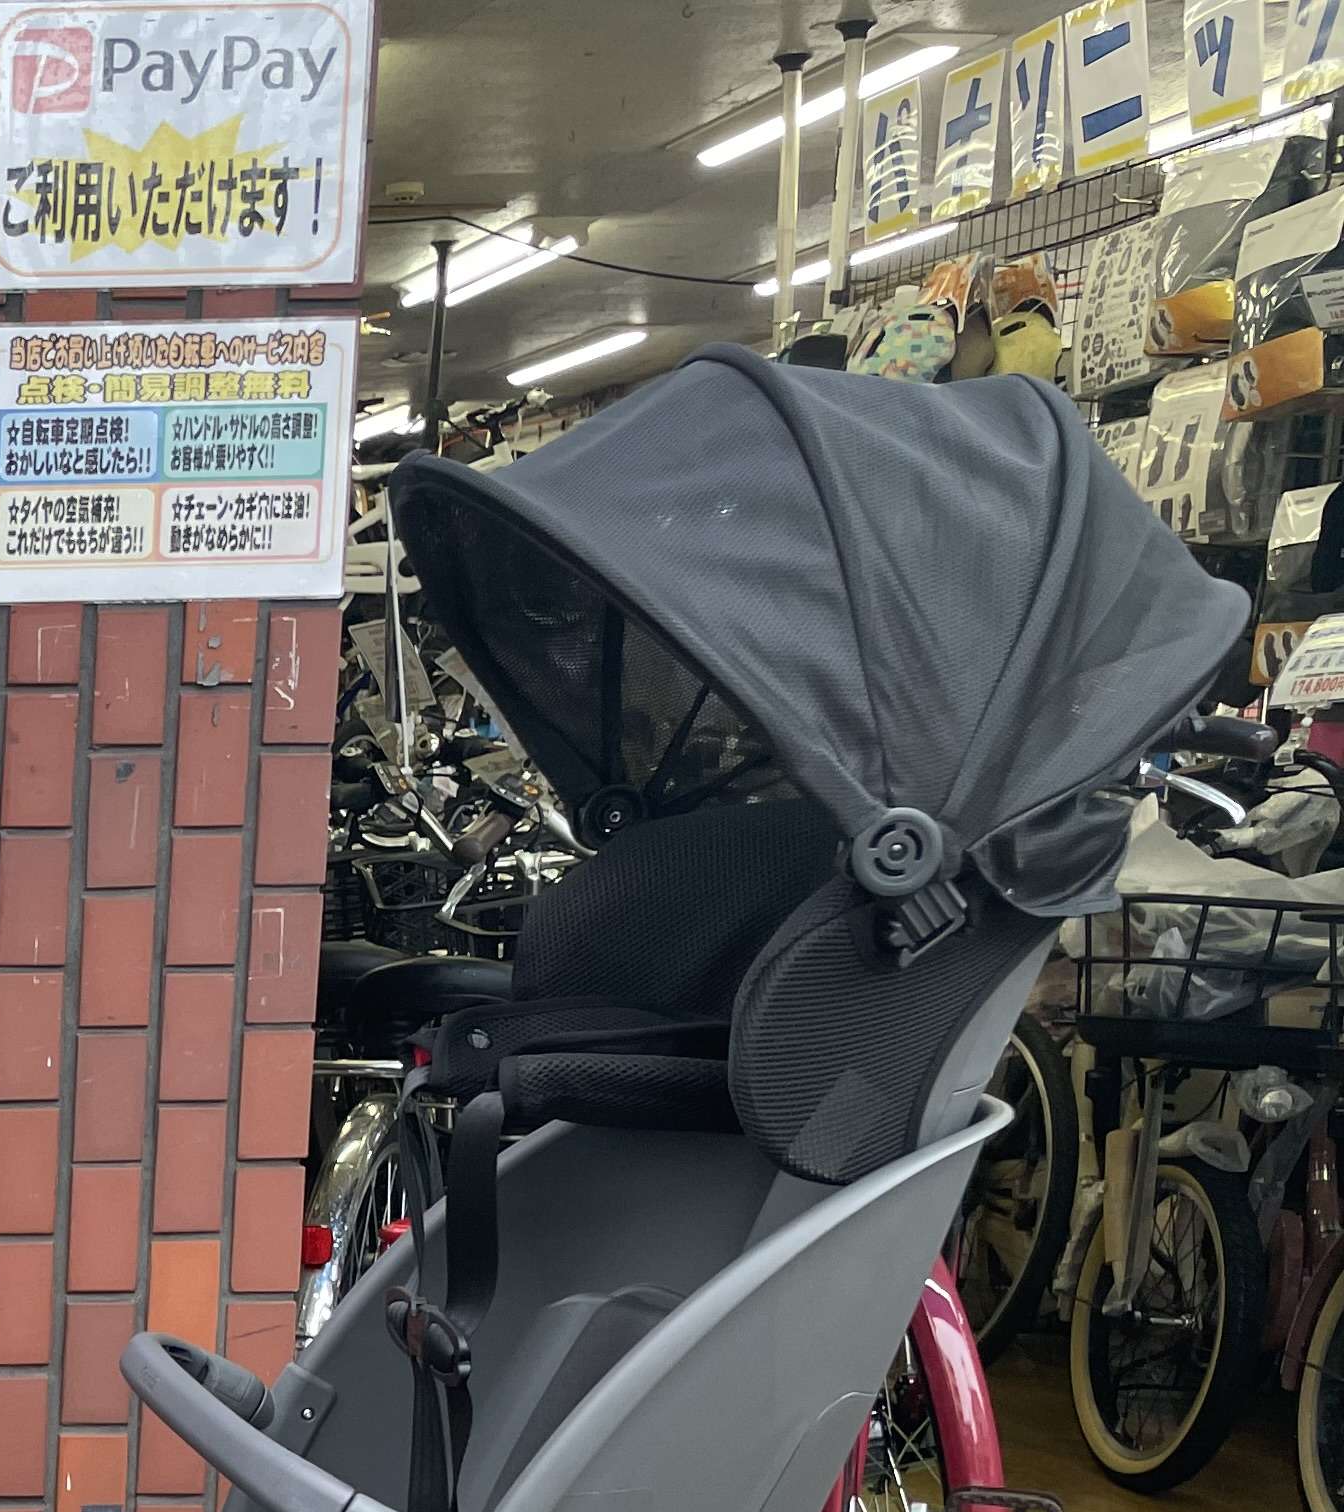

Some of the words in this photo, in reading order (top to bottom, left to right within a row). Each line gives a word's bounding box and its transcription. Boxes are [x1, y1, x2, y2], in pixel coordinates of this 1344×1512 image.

[101, 35, 337, 104] PayPay
[3, 158, 323, 243] ご利用いただけます！
[16, 371, 312, 404] 点検・簡易調整無料
